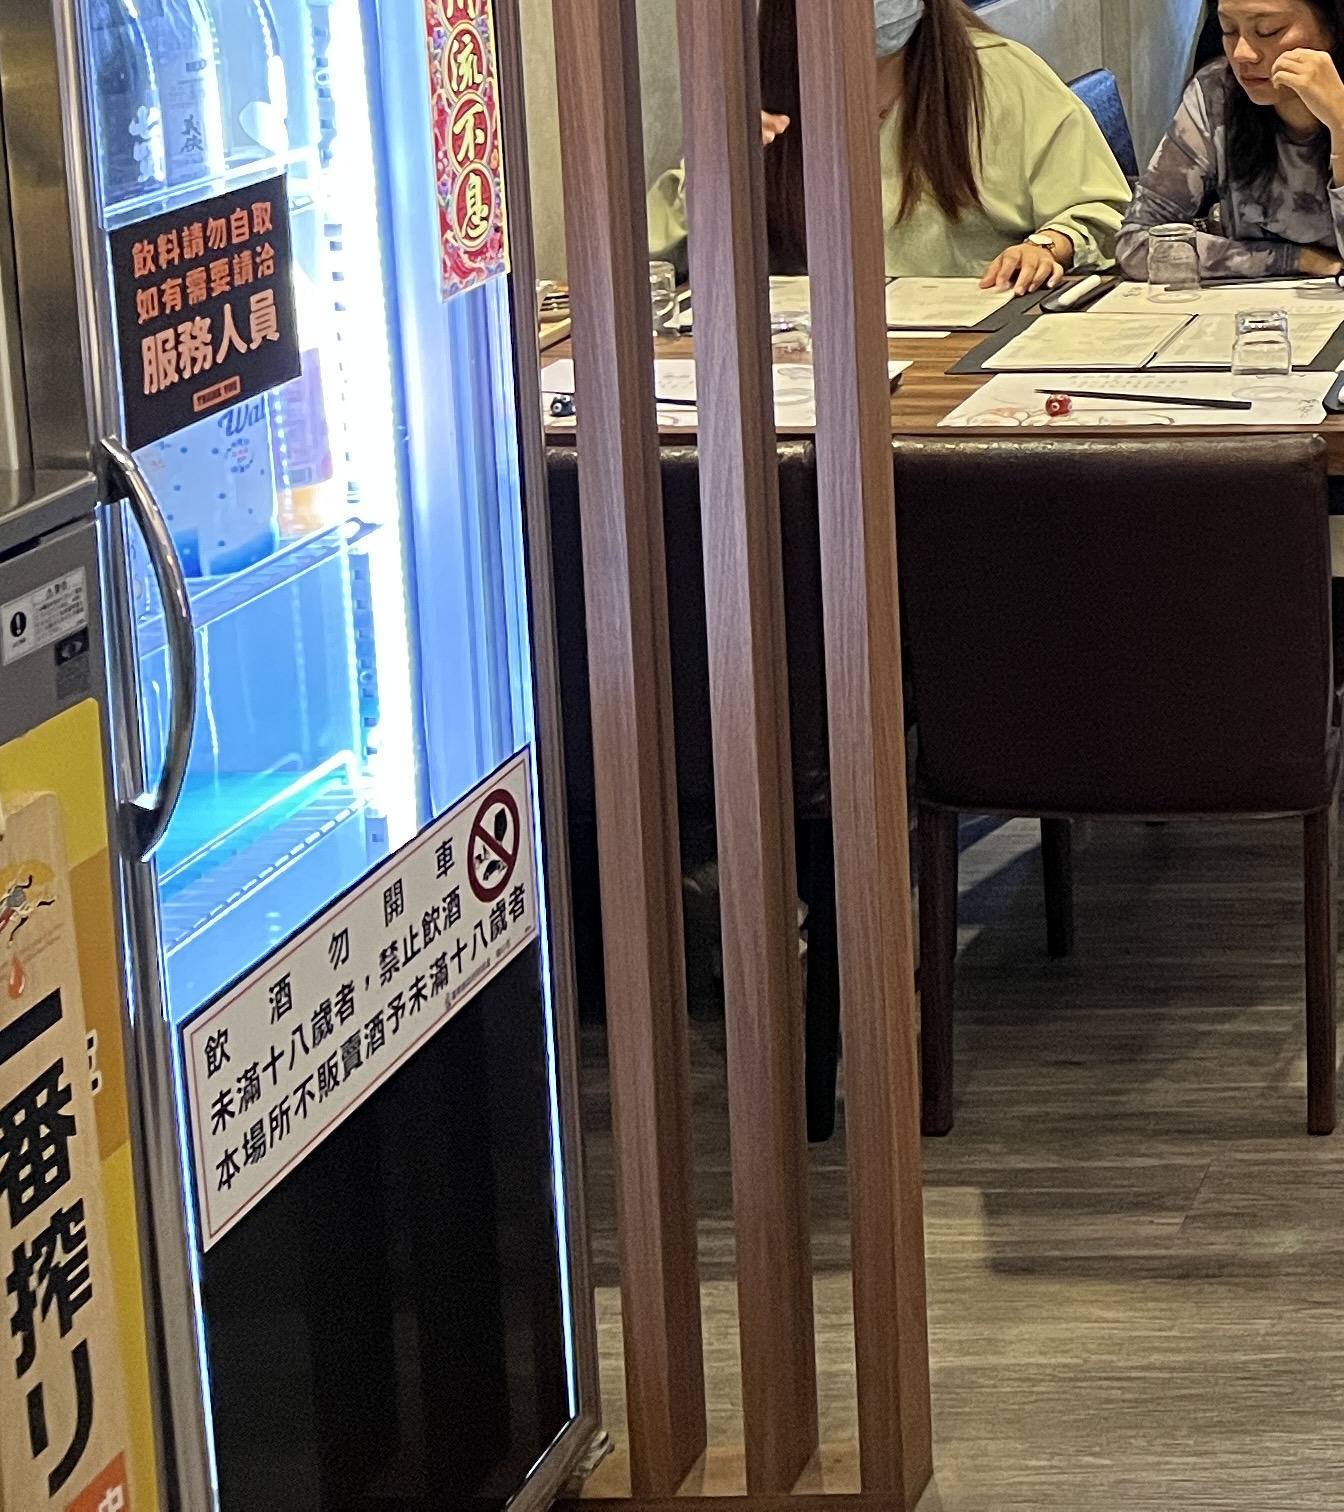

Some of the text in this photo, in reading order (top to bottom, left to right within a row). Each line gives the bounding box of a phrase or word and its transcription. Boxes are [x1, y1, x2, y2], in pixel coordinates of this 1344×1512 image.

[131, 201, 274, 279] 飲料請勿自取
[135, 242, 276, 325] 如有需要請洽
[141, 288, 281, 395] 服務人員
[203, 836, 456, 1080] 飲酒勿開車
[215, 882, 528, 1192] 本場所不販賣酒予未滿十八歲者
